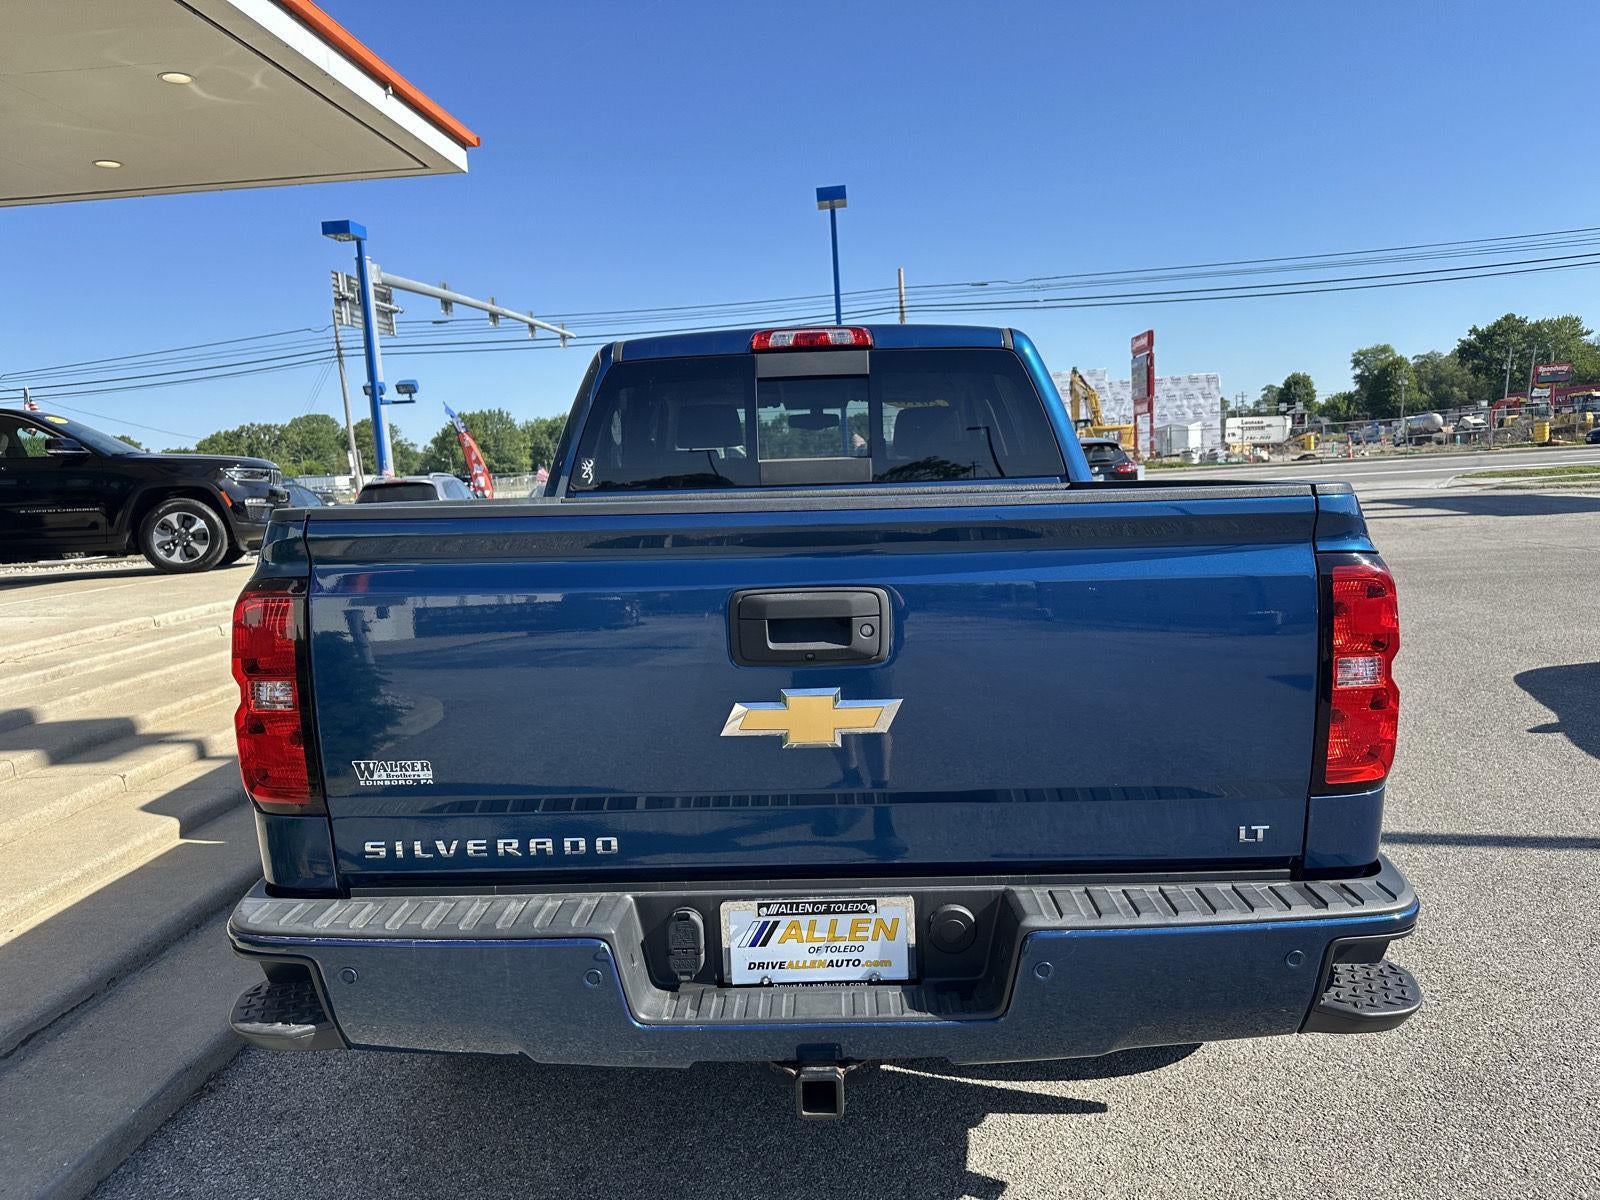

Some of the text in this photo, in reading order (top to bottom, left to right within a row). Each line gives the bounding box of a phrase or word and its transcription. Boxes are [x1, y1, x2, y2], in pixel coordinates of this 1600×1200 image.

[352, 761, 432, 779] WALKER
[1239, 825, 1270, 843] LT
[364, 836, 619, 859] SILVERADO
[779, 902, 868, 914] ALLEN OF TOLEDO
[778, 918, 899, 944] ALLEN
[808, 944, 865, 954] OF TOLEDO
[748, 959, 892, 971] DRIVEALLENAUTO.com
